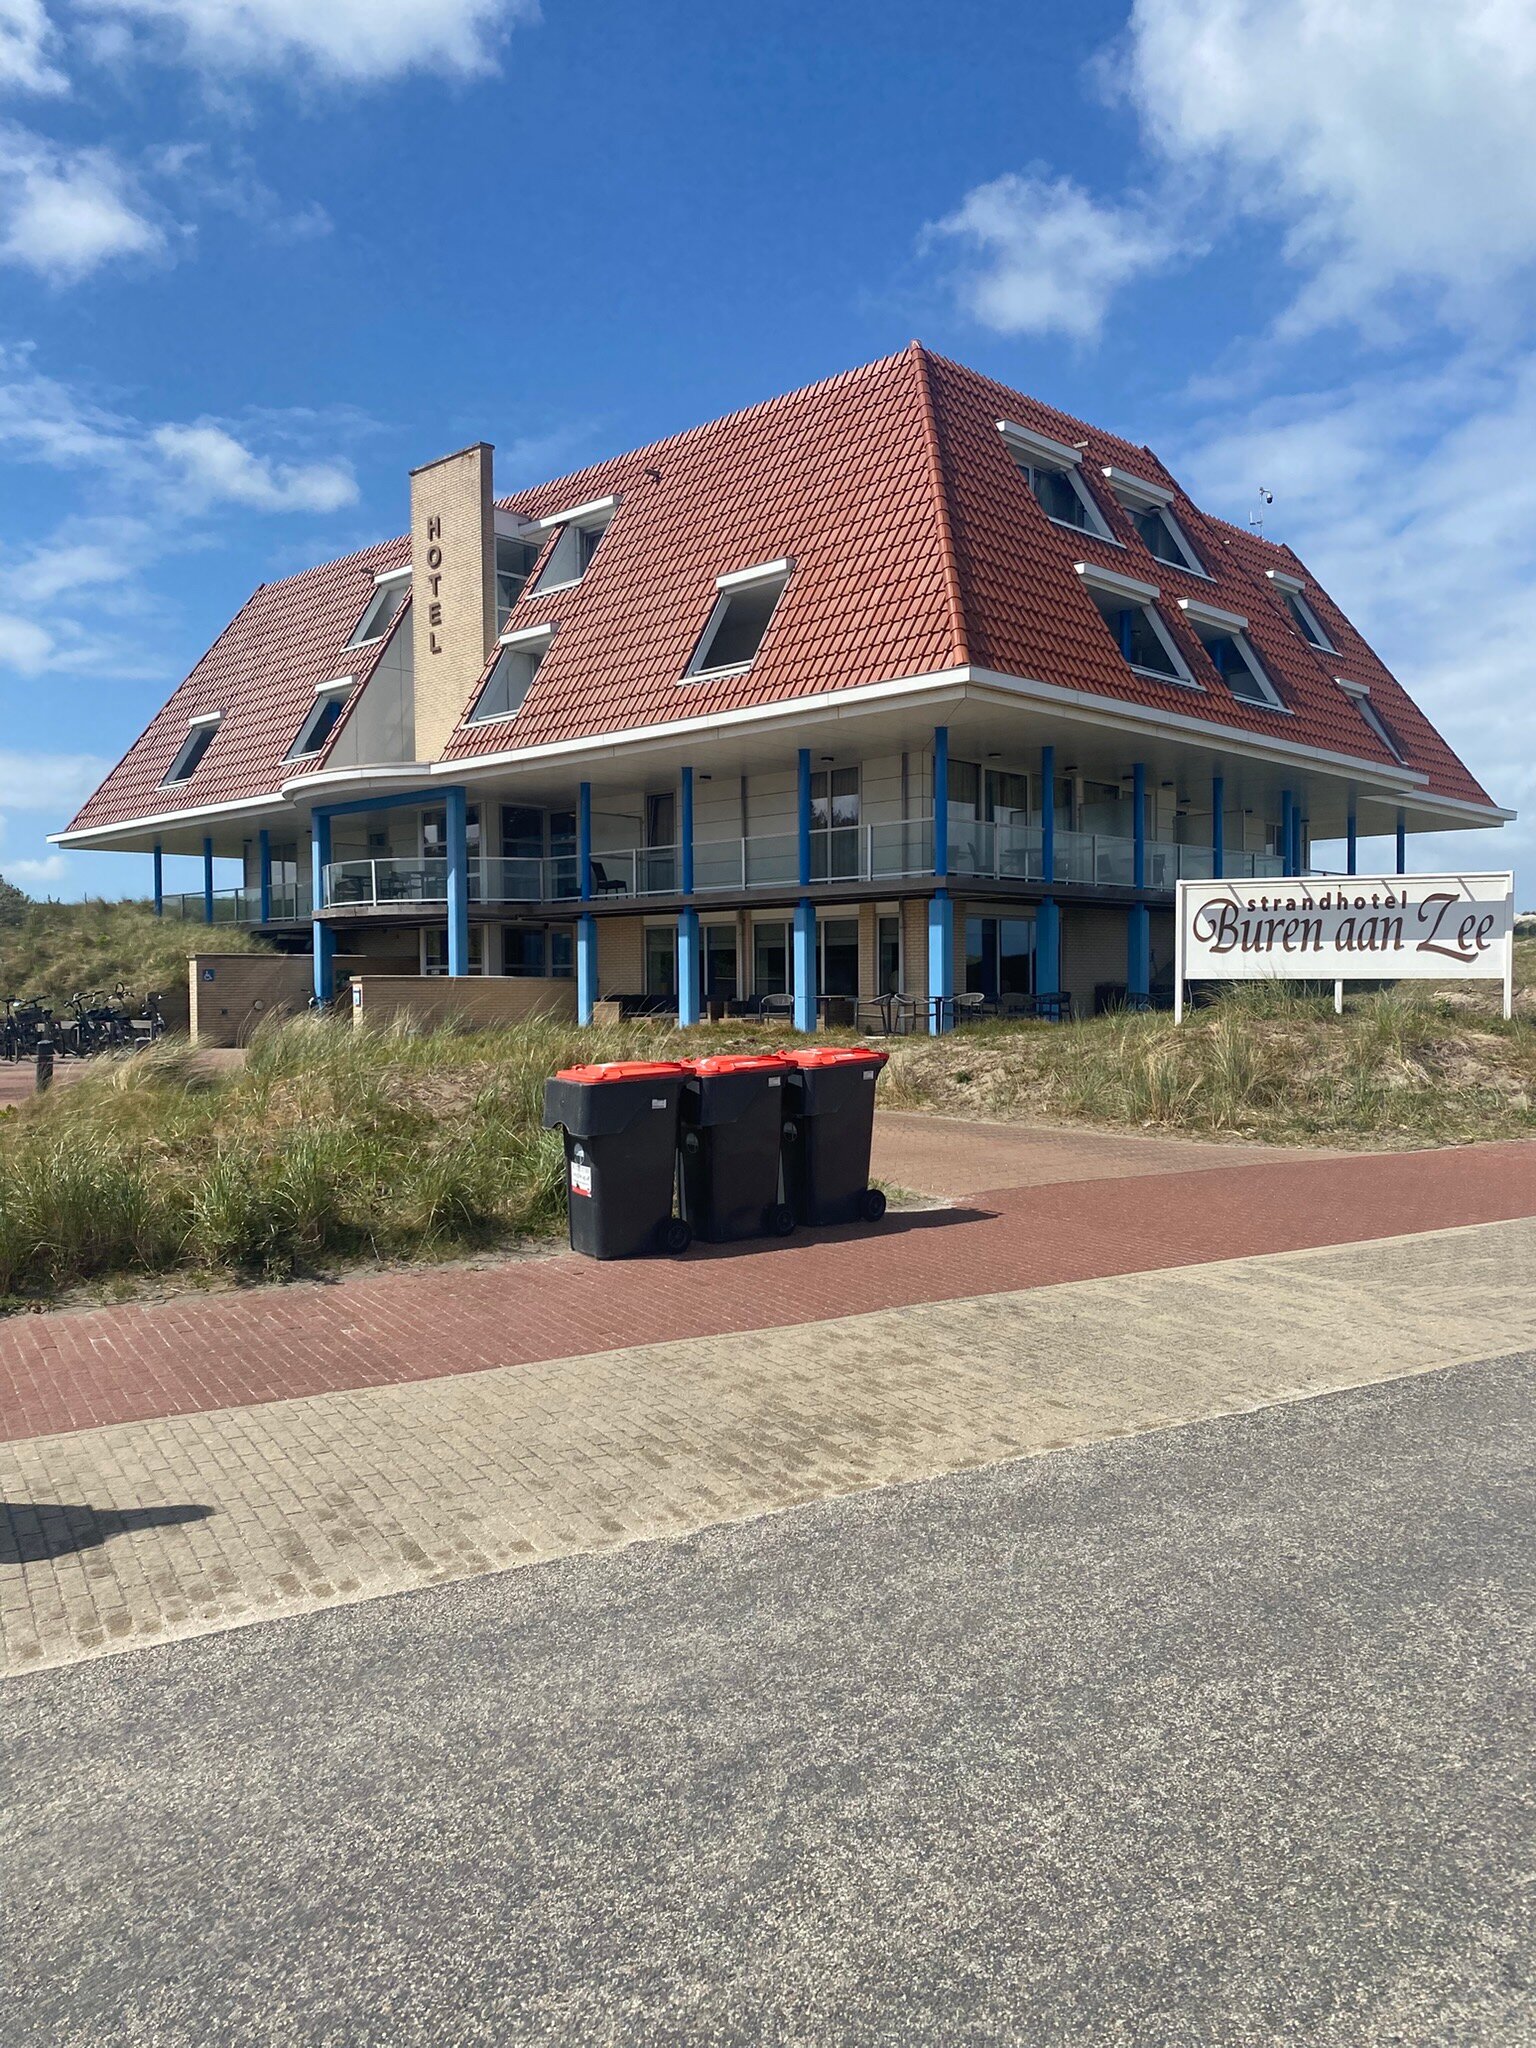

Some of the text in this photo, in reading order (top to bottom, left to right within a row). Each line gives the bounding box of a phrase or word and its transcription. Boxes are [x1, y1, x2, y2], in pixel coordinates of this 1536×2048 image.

[426, 515, 442, 655] HOTEL
[1193, 893, 1494, 963] Buren aan Zee
[1247, 890, 1407, 912] strandhotel
